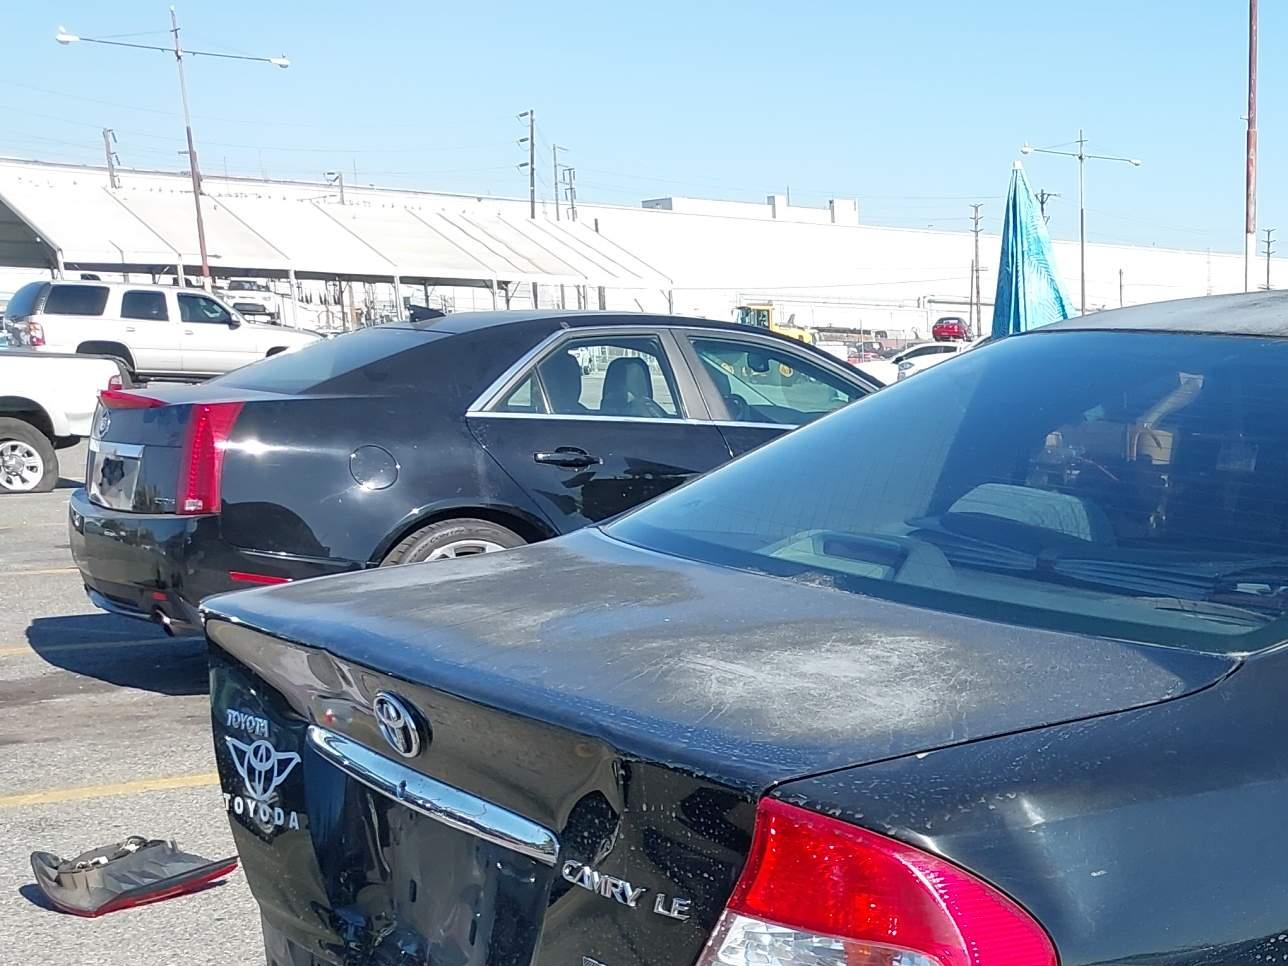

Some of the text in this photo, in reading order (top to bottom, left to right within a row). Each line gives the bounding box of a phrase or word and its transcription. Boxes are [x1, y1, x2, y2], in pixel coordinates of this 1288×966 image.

[226, 709, 269, 737] TOYOTA
[223, 793, 300, 830] TOYODA
[562, 859, 692, 921] CAMRY LE
